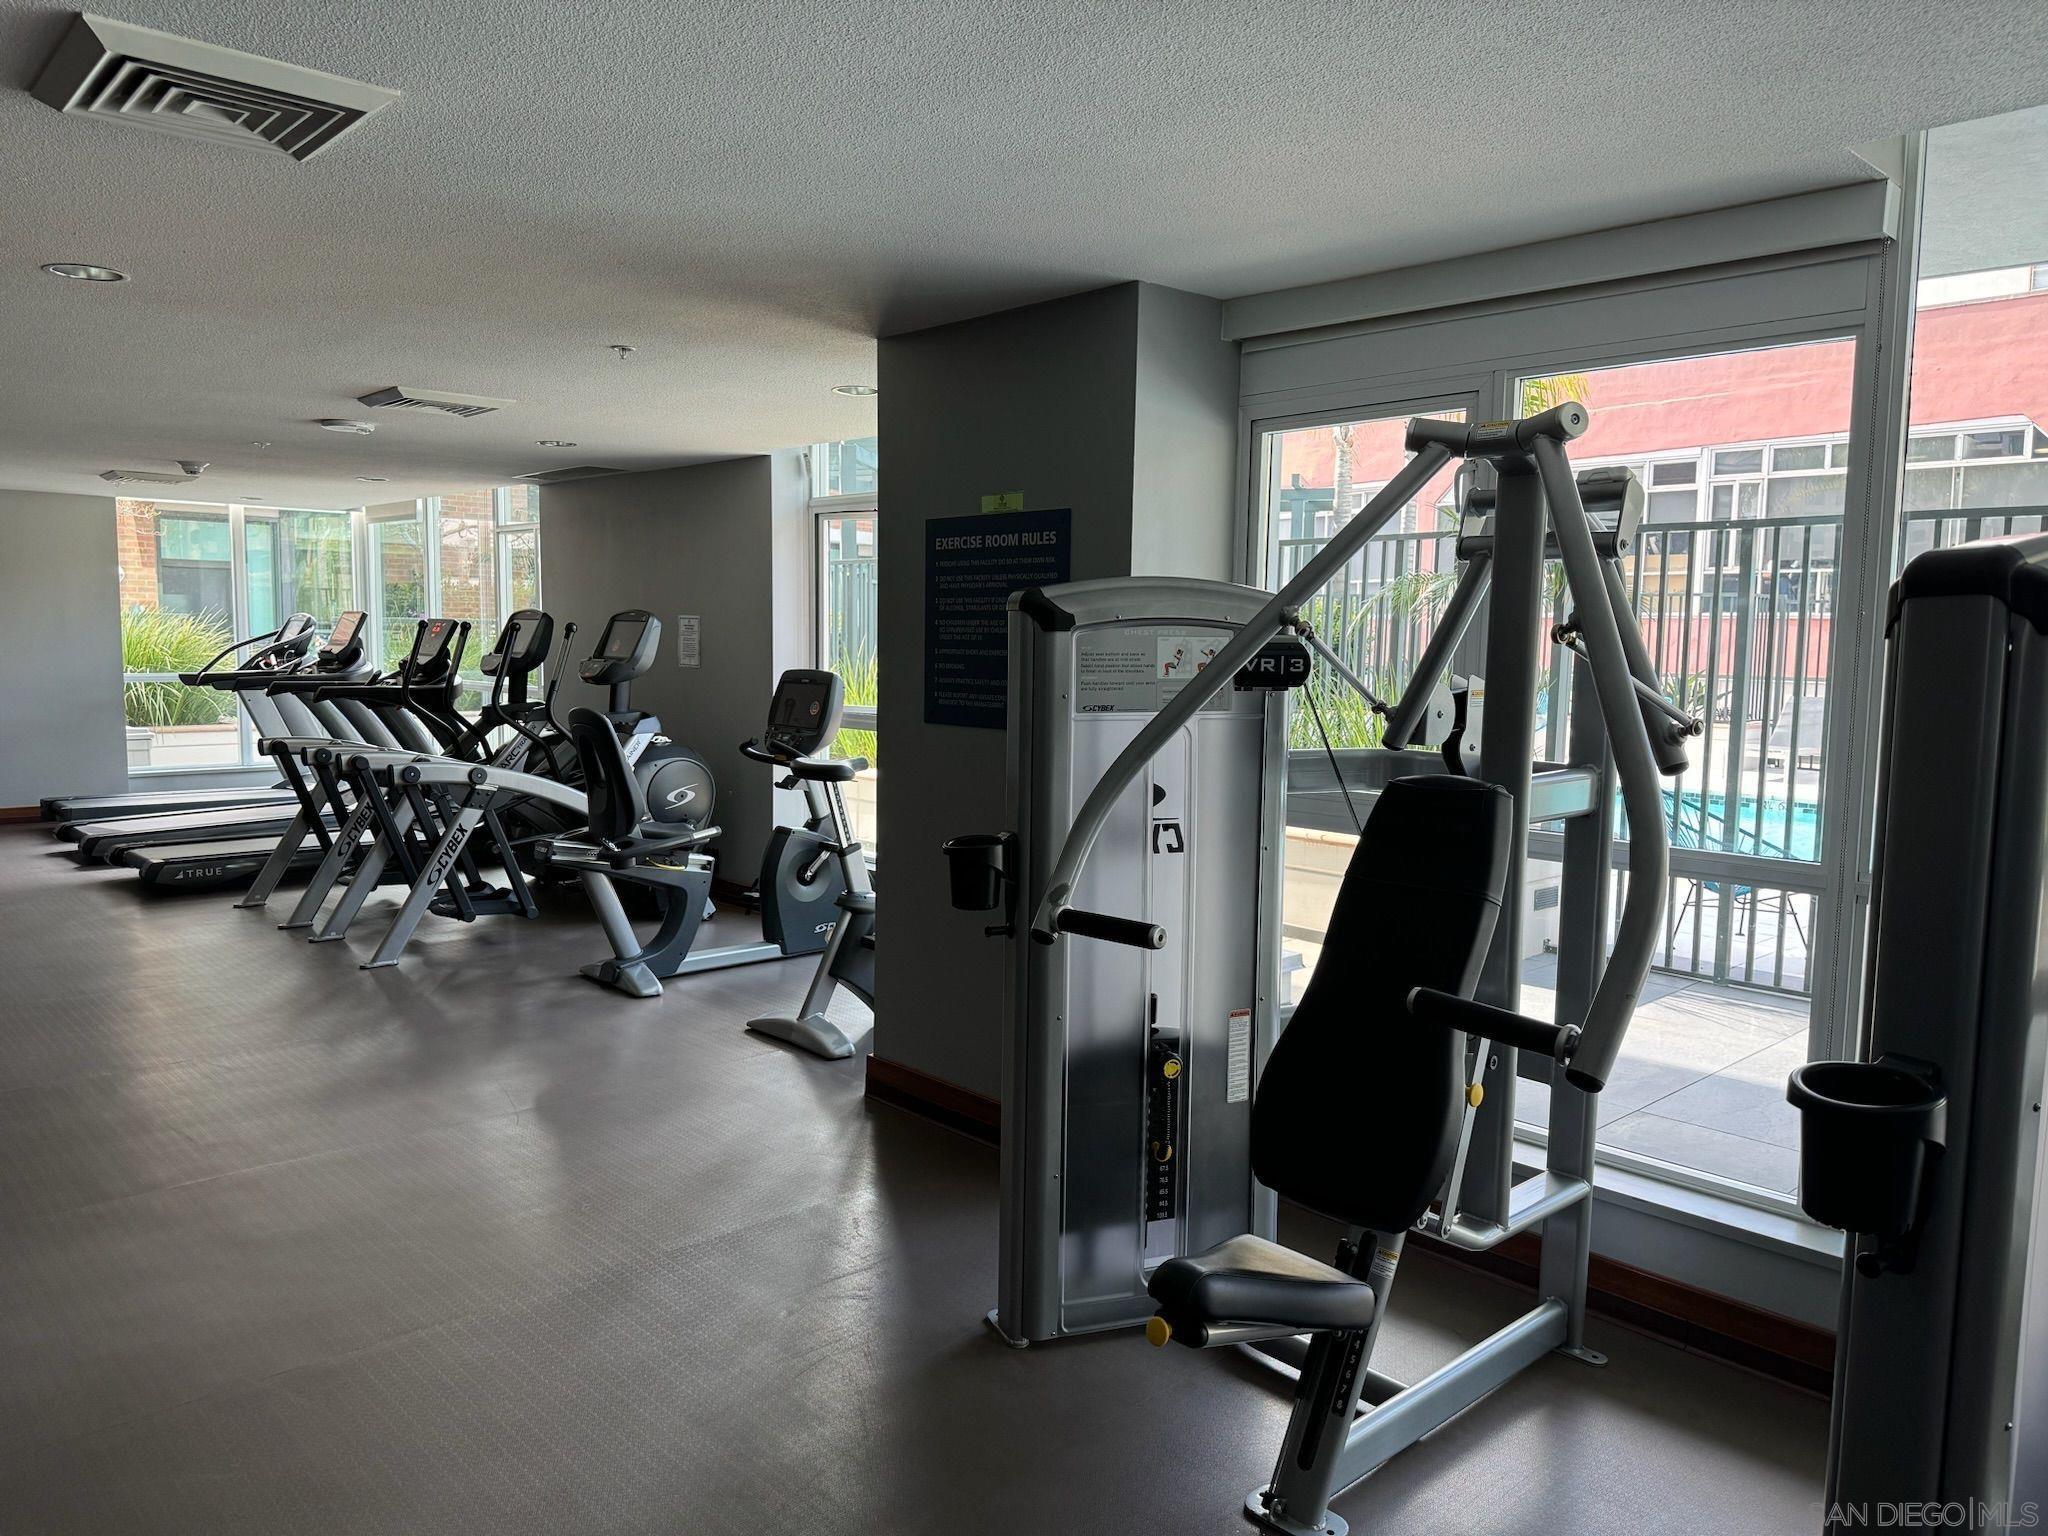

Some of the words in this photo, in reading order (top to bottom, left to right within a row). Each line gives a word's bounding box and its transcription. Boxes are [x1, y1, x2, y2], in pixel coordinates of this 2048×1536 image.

[935, 536, 982, 550] EXERCISE
[985, 533, 1019, 548] ROOM
[1022, 531, 1056, 546] RULES
[441, 822, 468, 866] CYBEX
[186, 868, 222, 878] TRUE
[1350, 1355, 1356, 1363] 5
[1346, 1370, 1351, 1378] 6
[1341, 1385, 1347, 1393] 7
[1337, 1400, 1343, 1409] 8
